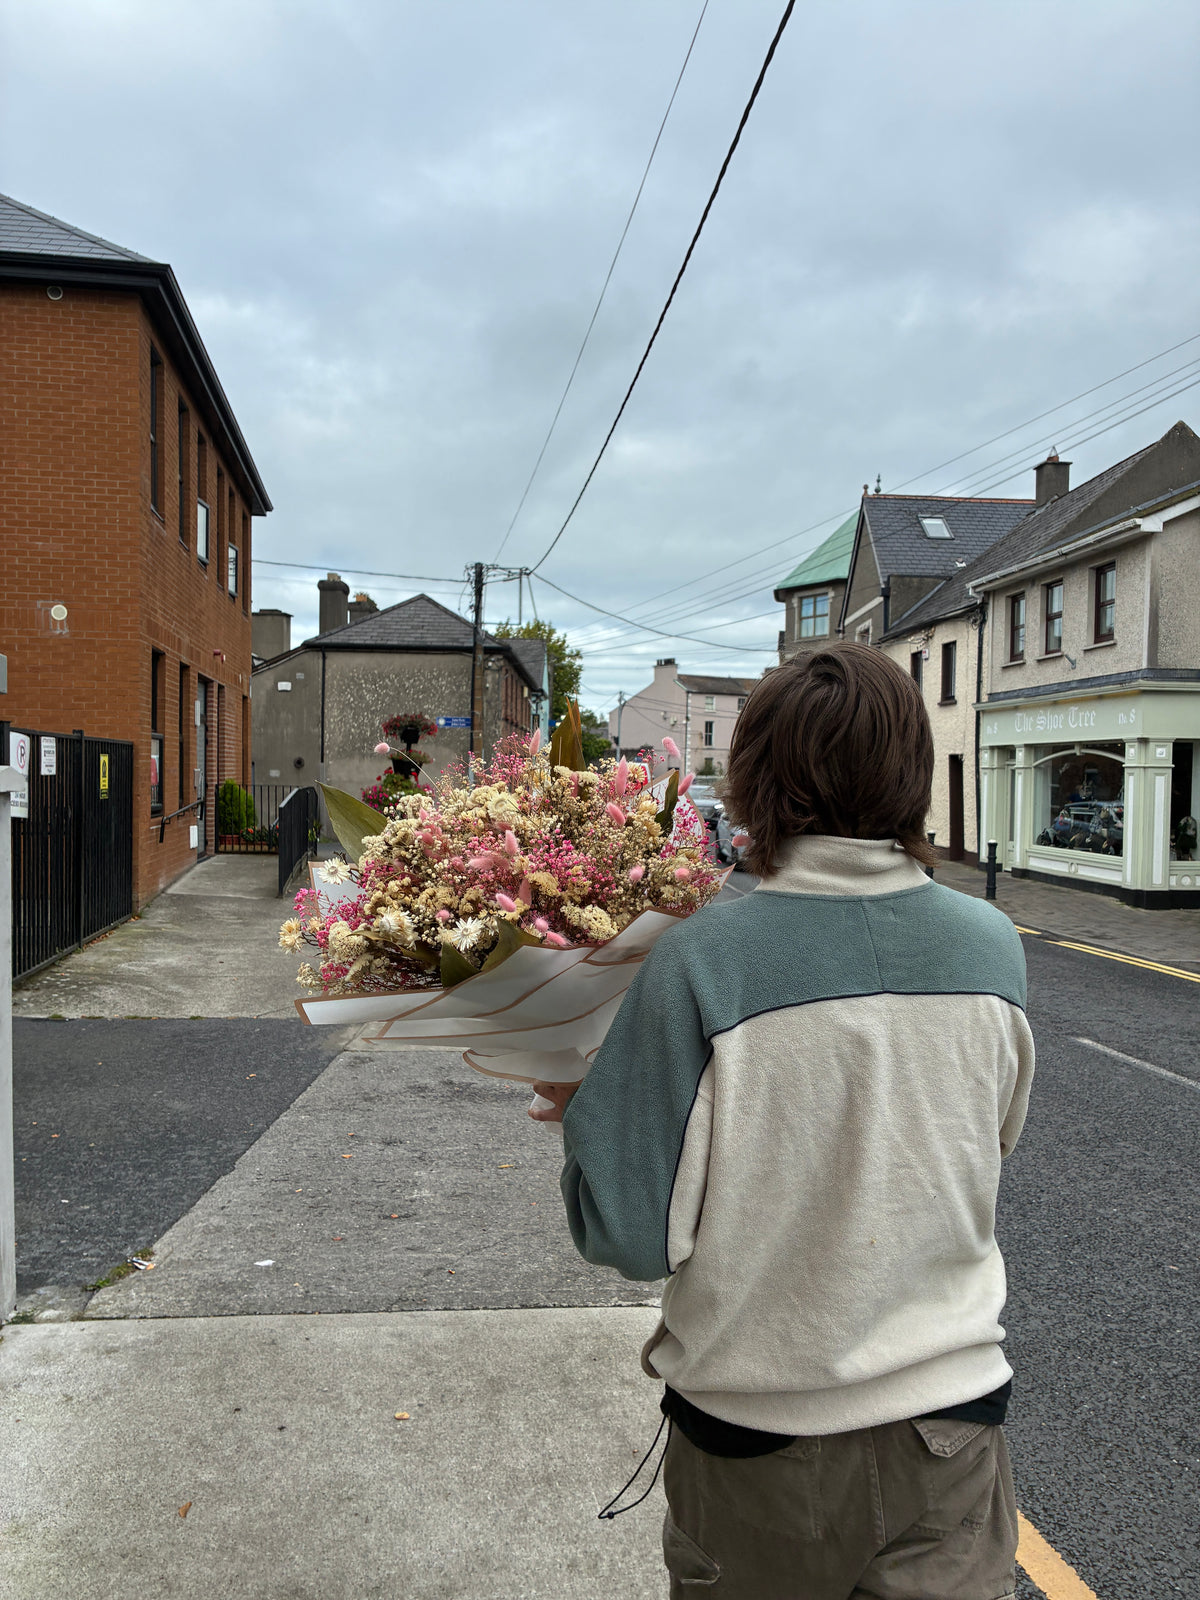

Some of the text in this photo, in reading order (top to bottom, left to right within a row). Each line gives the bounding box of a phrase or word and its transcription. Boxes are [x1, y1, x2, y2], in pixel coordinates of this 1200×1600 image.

[1014, 706, 1096, 733] The Shoe Tree
